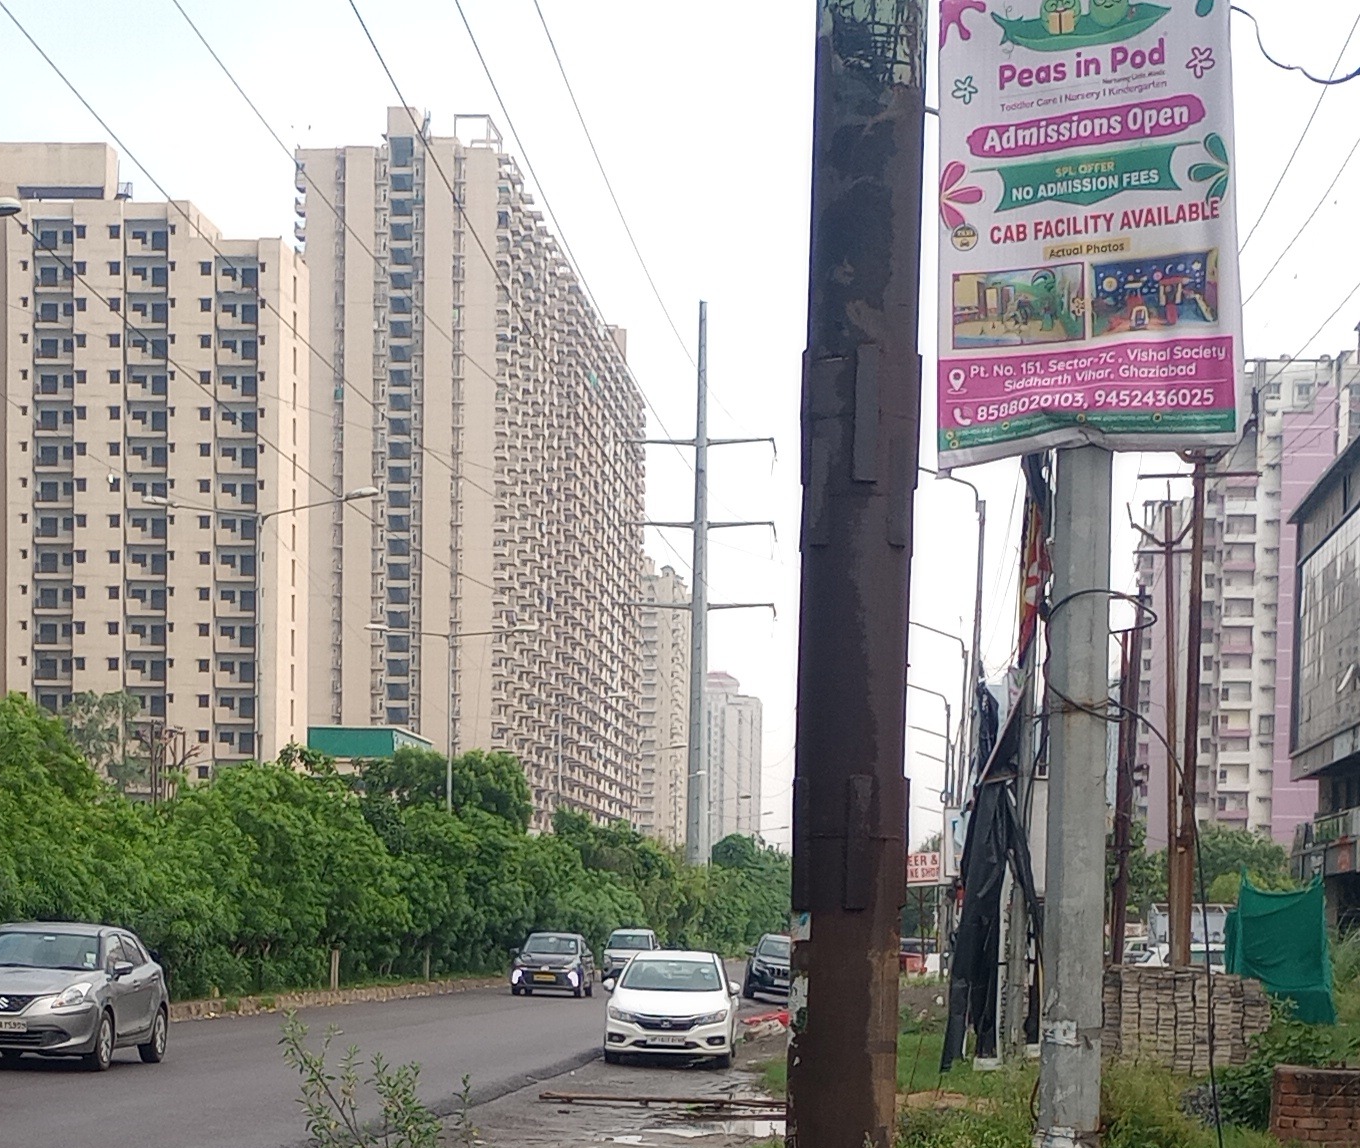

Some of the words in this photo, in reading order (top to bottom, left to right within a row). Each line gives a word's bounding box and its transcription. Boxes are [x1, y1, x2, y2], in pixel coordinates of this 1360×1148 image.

[999, 62, 1067, 91] Peas
[1075, 51, 1101, 78] in
[1110, 37, 1165, 74] Pod
[1000, 100, 1034, 113] Toddler
[1036, 97, 1058, 108] Care
[1064, 89, 1101, 103] Nursery
[1108, 79, 1168, 97] Kindergarten
[983, 114, 1122, 152] Admissions
[1127, 102, 1189, 135] Open
[1055, 165, 1076, 178] SPL
[1078, 160, 1115, 175] OFFER
[1011, 185, 1034, 201] NO
[1037, 173, 1119, 199] ADMISSION
[1122, 169, 1159, 187] FEES
[990, 223, 1028, 245] CAB
[1033, 212, 1115, 241] FACILITY
[1120, 199, 1220, 231] AVAILABLE
[1049, 245, 1083, 259] Actual
[1086, 242, 1125, 254] Photos
[992, 364, 1017, 378] No.
[1126, 347, 1171, 363] Vishal
[1004, 373, 1072, 393] Siddharth
[1118, 362, 1197, 378] Ghaziabad
[1094, 388, 1215, 407] 9452436025
[908, 855, 927, 866] EER
